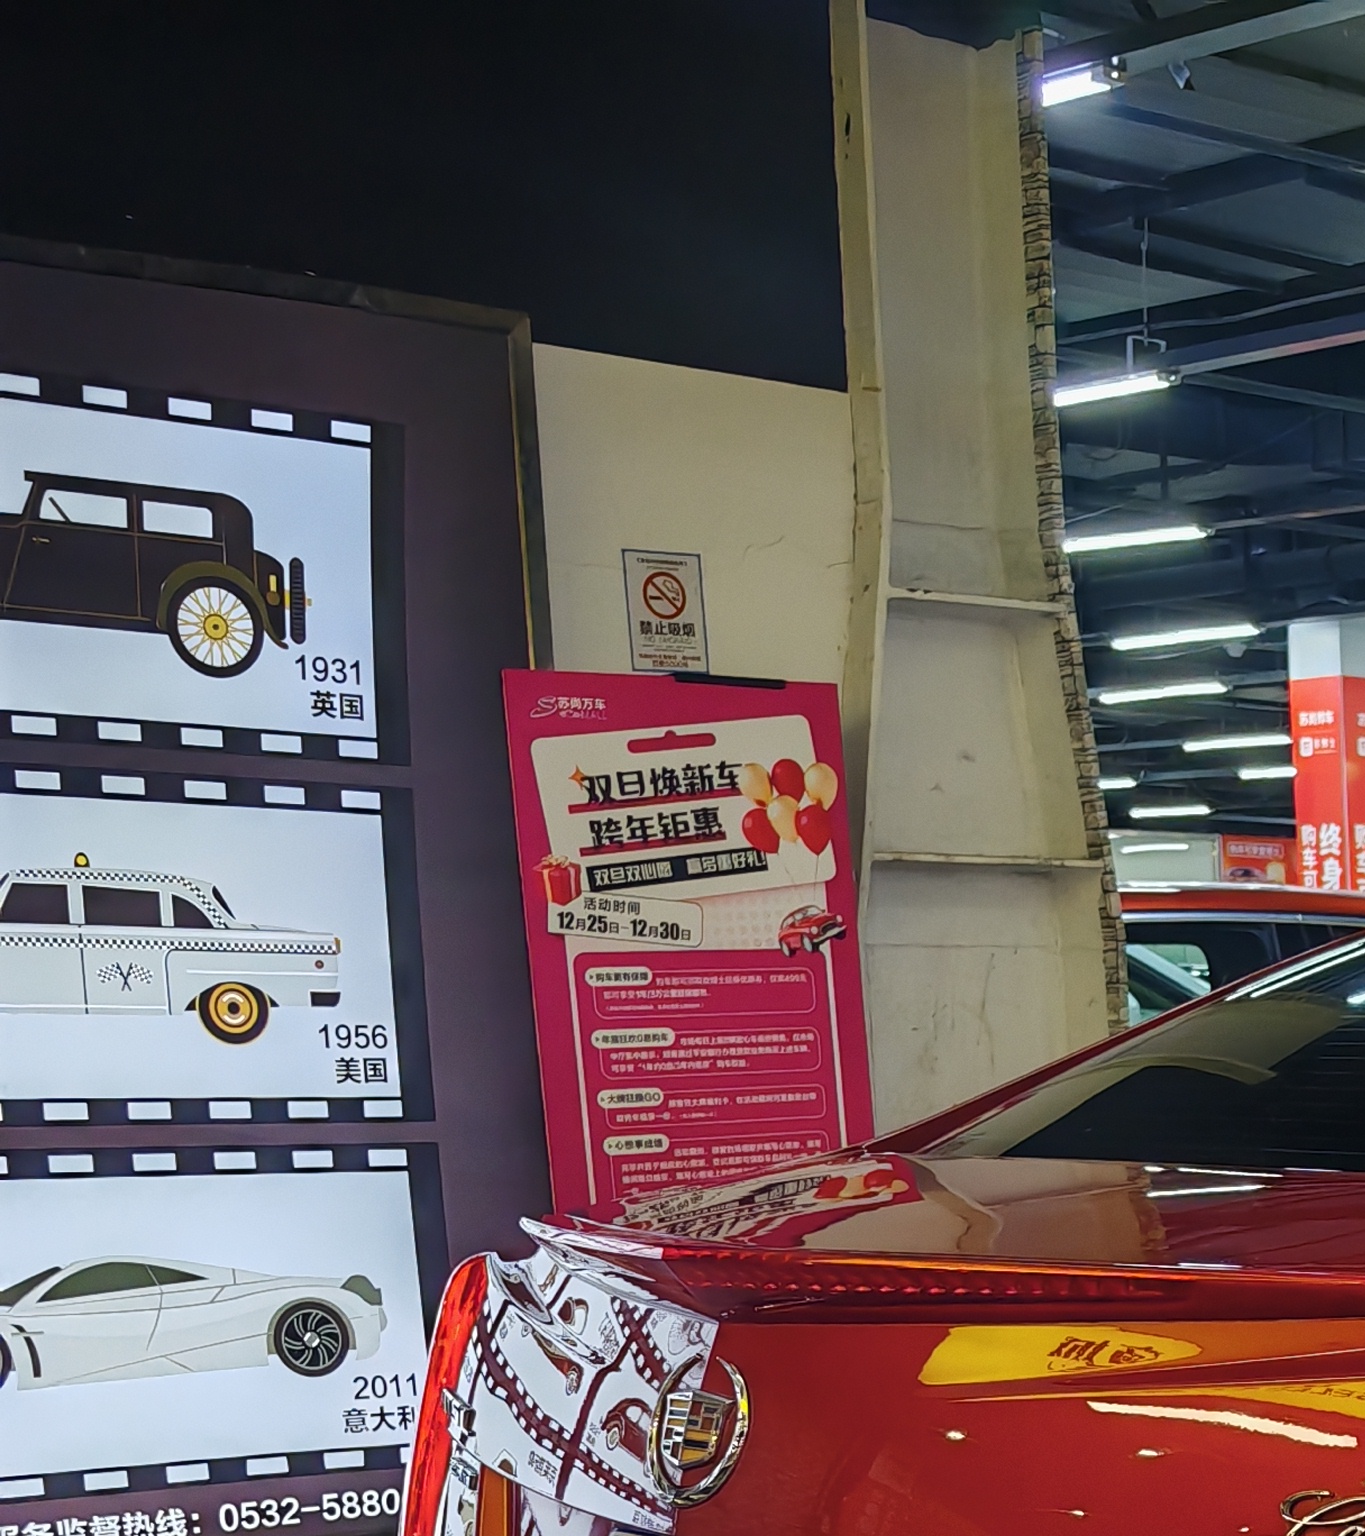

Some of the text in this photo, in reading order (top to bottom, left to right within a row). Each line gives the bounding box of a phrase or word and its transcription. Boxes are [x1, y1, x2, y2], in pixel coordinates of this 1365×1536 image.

[293, 653, 363, 688] 1931
[309, 690, 365, 722] 英国
[588, 806, 724, 849] 跨年钜惠
[583, 896, 641, 916] 活动时间
[317, 1022, 389, 1051] 1956
[334, 1055, 389, 1085] 美国
[352, 1372, 418, 1400] 2011
[342, 1405, 415, 1434] 意大利
